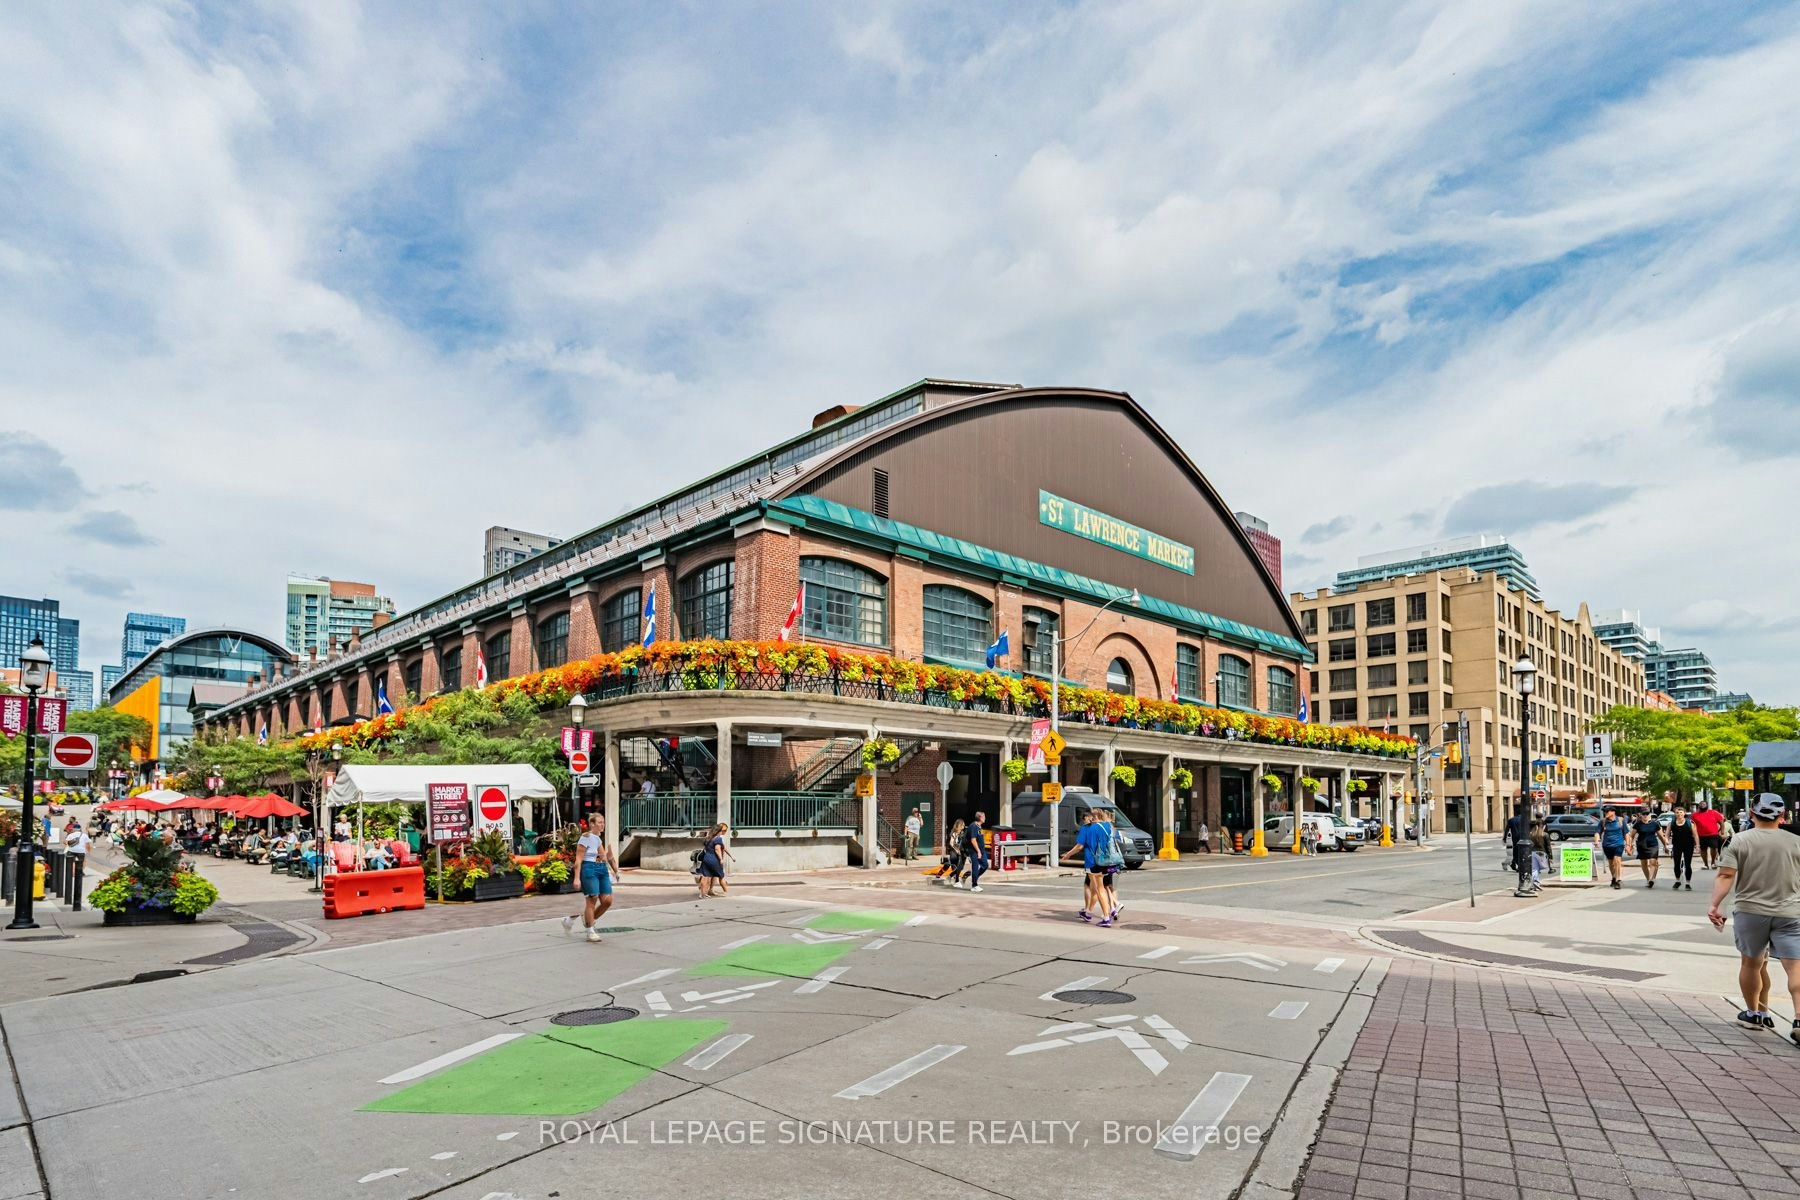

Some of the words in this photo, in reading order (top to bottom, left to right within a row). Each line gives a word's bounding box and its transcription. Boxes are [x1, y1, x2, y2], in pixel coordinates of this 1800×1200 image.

[1073, 508, 1140, 551] LAWRENCE
[1147, 535, 1189, 569] MARKET
[3, 699, 13, 730] STREET
[12, 699, 22, 733] MARKET
[43, 702, 52, 731] STREET
[50, 703, 61, 733] MARKE
[1032, 727, 1049, 736] OLD
[434, 786, 465, 794] MARKET
[485, 822, 504, 830] ROAD
